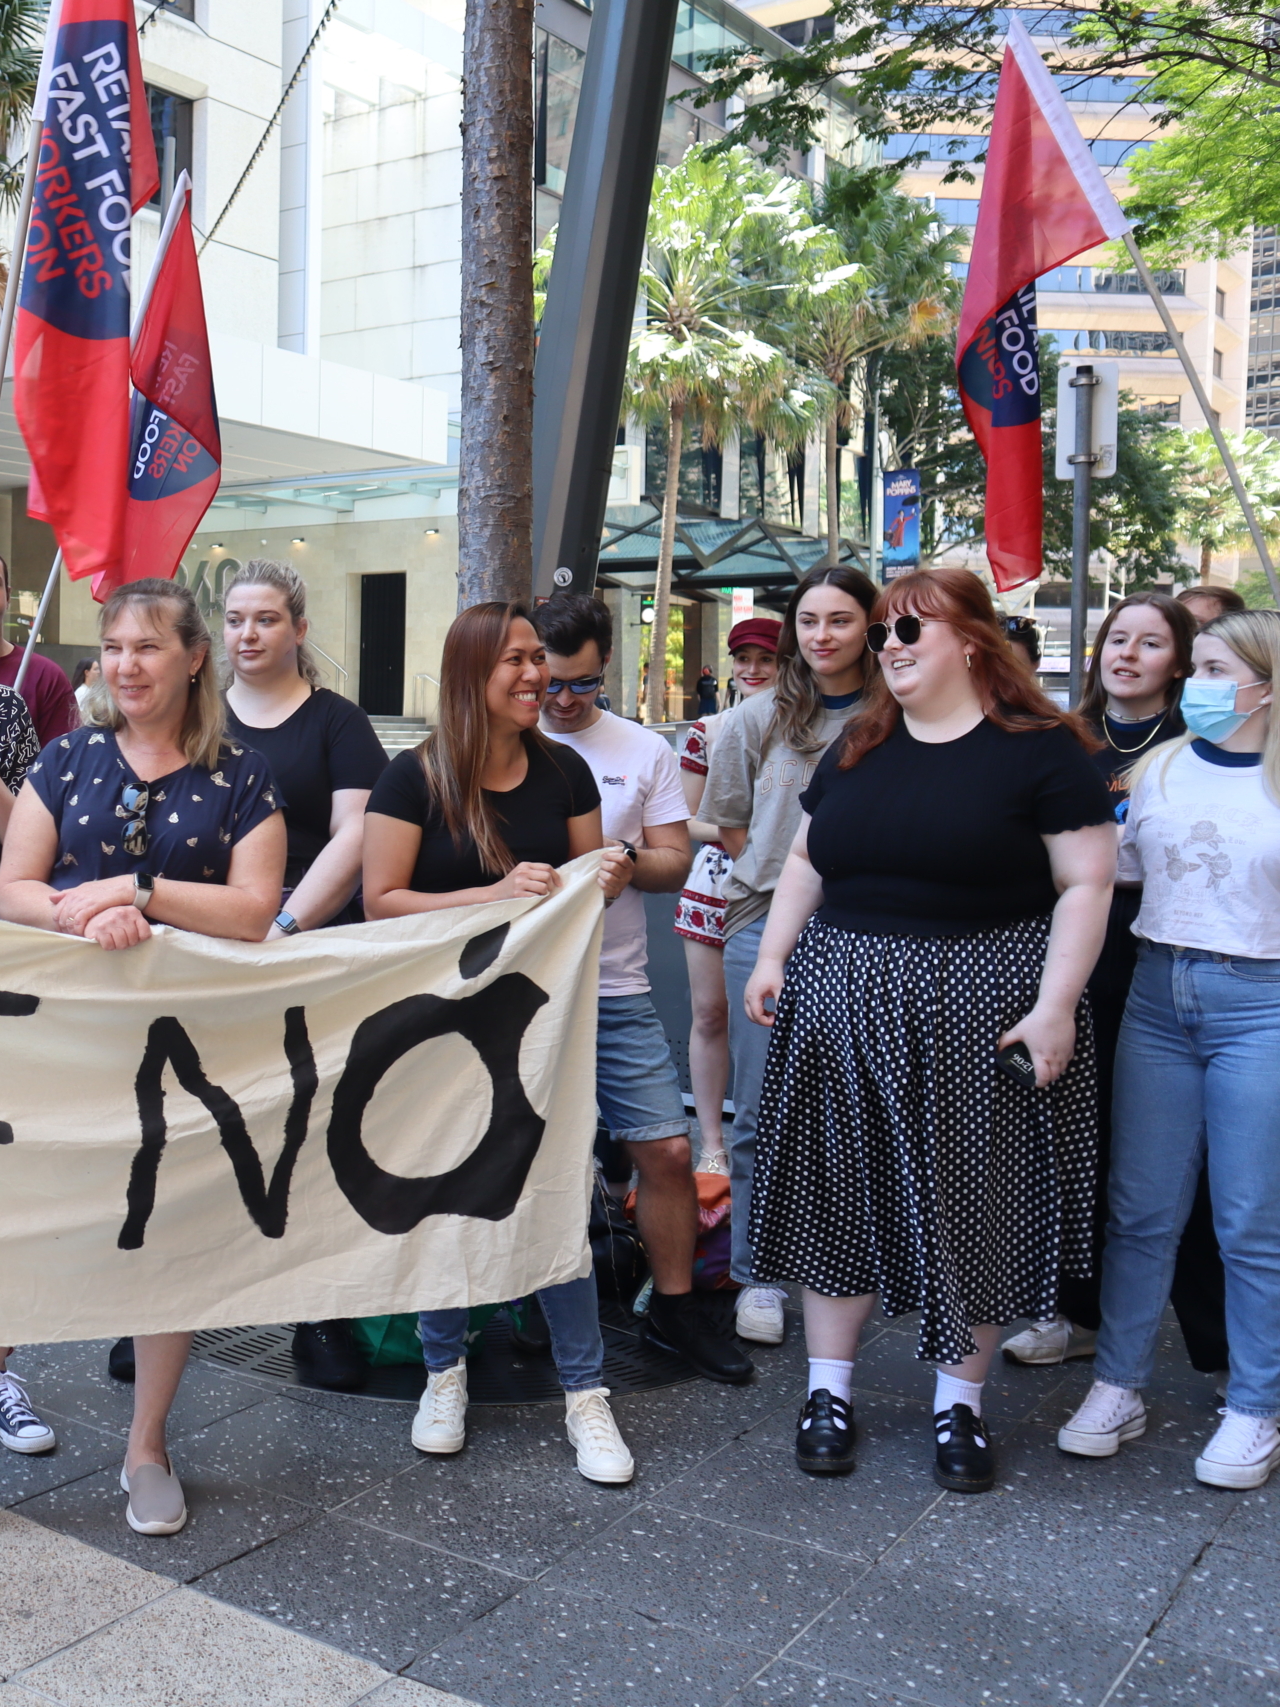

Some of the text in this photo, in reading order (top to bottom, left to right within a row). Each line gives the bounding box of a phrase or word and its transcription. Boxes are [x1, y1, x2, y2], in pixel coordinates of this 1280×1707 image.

[48, 62, 110, 161] FAST
[37, 128, 114, 299] ORKERS
[996, 309, 1039, 396] FOOD
[886, 485, 916, 496] POPPINS
[891, 479, 912, 490] MARY
